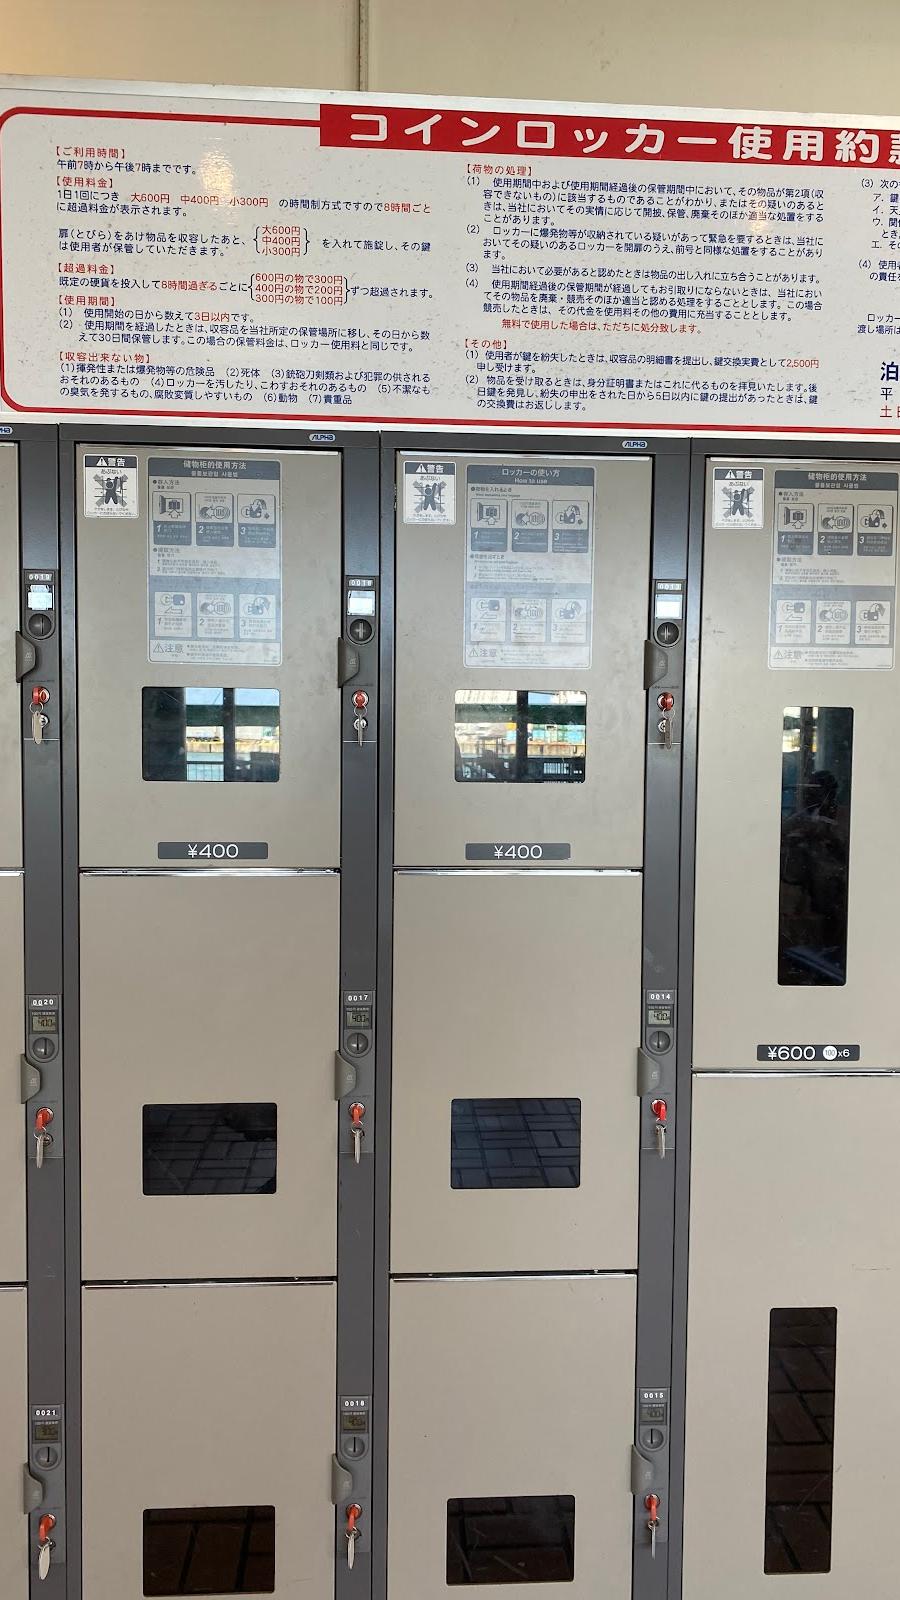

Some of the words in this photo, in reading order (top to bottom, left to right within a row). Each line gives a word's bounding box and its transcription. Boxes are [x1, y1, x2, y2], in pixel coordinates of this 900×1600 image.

[56, 147, 126, 159] 【ご利用時間】
[57, 160, 196, 175] 午前7時から午後7時までです。
[466, 164, 533, 176] 【荷物の処理】
[56, 176, 113, 188] 【使用料金】
[467, 176, 480, 186] (1)
[493, 178, 824, 198] 使用期間中および使用期間経過後の保管期間中において、その物品が第2項(収
[861, 179, 874, 188] (3)
[880, 179, 900, 189] 次の
[58, 190, 120, 201] 1日1回につき
[130, 192, 170, 203] 大600円
[180, 194, 219, 205] 中400円
[229, 197, 269, 207] 小300円
[279, 199, 431, 214] の時間制方式ですので8時間ごと
[483, 190, 824, 211] 容できないもの)に該当するものであることがわかり、またはその疑いのあると
[57, 202, 187, 217] に超過料金が表示されます。
[890, 205, 900, 215] 天
[484, 214, 555, 226] ことがあります。
[889, 218, 900, 228] 関
[262, 225, 301, 236] 大600円
[466, 224, 480, 235] (2)
[493, 227, 823, 246] ロッカーに爆発物等が収納されている疑いがあって緊急を要するときは、当社に
[59, 241, 225, 256] は使用者が保管していただきます。
[262, 236, 301, 246] 中400円
[322, 238, 430, 252] を入れて施錠し、その鍵
[483, 238, 823, 258] おいてその疑いのあるロッカーを開扉のうえ、前号と同様な処置をすることがあり
[262, 246, 301, 257] 小300円
[483, 250, 506, 260] ます。
[58, 262, 114, 274] 【超過料金】
[858, 260, 871, 269] (4)
[255, 273, 343, 284] 600円の物で300円
[465, 262, 479, 272] (3)
[492, 264, 820, 284] 当社において必要があると認めたときは物品の出し入れに立ち合うことがあります。
[59, 276, 248, 292] 既定の硬貨を投入して8時間過ぎるごとに
[255, 284, 343, 295] 400円の物で200円
[350, 286, 433, 300] ずつ超過されます。
[465, 279, 478, 288] (4)
[492, 280, 822, 298] 使用期間経過後の保管期間が経過してもお引取りにならないときは、当社におい
[58, 295, 115, 306] 【使用期間】
[255, 295, 343, 306] 300円の物で100円
[59, 308, 72, 318] (1)
[84, 308, 254, 323] 使用開始の日から数えて3日以内です。
[483, 303, 792, 322] 競売したときは、その代金を使用料その他の費用に充当することとします。
[59, 320, 73, 330] (2)
[85, 320, 430, 341] 使用期間を経過したときは、収容品を当社所定の保管場所に移し、その日から数
[502, 319, 702, 334] 無料で使用した場合は、ただちに処分致します。
[78, 332, 413, 352] えて30日間保管します。この場合の保管料金は、ロッカー使用料と同じです。
[464, 339, 507, 350] 【その他】
[58, 352, 150, 364] 【収容出来ない物】
[466, 350, 479, 359] (1)
[485, 351, 819, 369] 使用者が鍵を紛失したときは、収容品の明細書を提出し、鍵交換実費として2,500円
[61, 363, 215, 377] (1)揮発性または爆発物等の危険品
[226, 368, 260, 379] (2)死体
[271, 369, 430, 383] (3)銃砲刀剣類および犯罪の供される
[477, 363, 536, 374] 申し受けます。
[60, 375, 140, 386] おそれのあるもの
[150, 378, 366, 393] (4)ロッカーを汚したり、こわすおそれのあるもの
[378, 384, 430, 395] (5)不潔なも
[465, 375, 479, 385] (2)
[486, 376, 818, 393] 物品を受け取るときは、身分証明書またはこれに代るものを拝見いたします。後
[60, 387, 253, 401] の臭気を発するもの、腐敗変質しやすいもの
[263, 392, 298, 403] (6)動物
[308, 394, 353, 405] (7)貴重品
[477, 388, 818, 405] 日鍵を発見し、紛失の申出をされた日から5日以内に鍵の提出があったときは、鍵
[881, 388, 893, 401] 平
[477, 399, 586, 412] の交換費はお返しします。
[108, 458, 125, 466] 警告
[427, 465, 444, 473] 警告
[502, 468, 560, 477] ロッカーの使い方
[736, 470, 752, 479] 警告
[198, 525, 204, 534] 2
[240, 527, 246, 535] 3
[514, 532, 520, 540] 2
[554, 532, 560, 541] 3
[820, 536, 826, 544] 2
[858, 536, 865, 544] 3
[199, 618, 205, 626] 2
[241, 619, 246, 627] 3
[188, 844, 239, 858] ¥400
[494, 845, 542, 859] ¥400
[768, 1046, 816, 1060] ¥600
